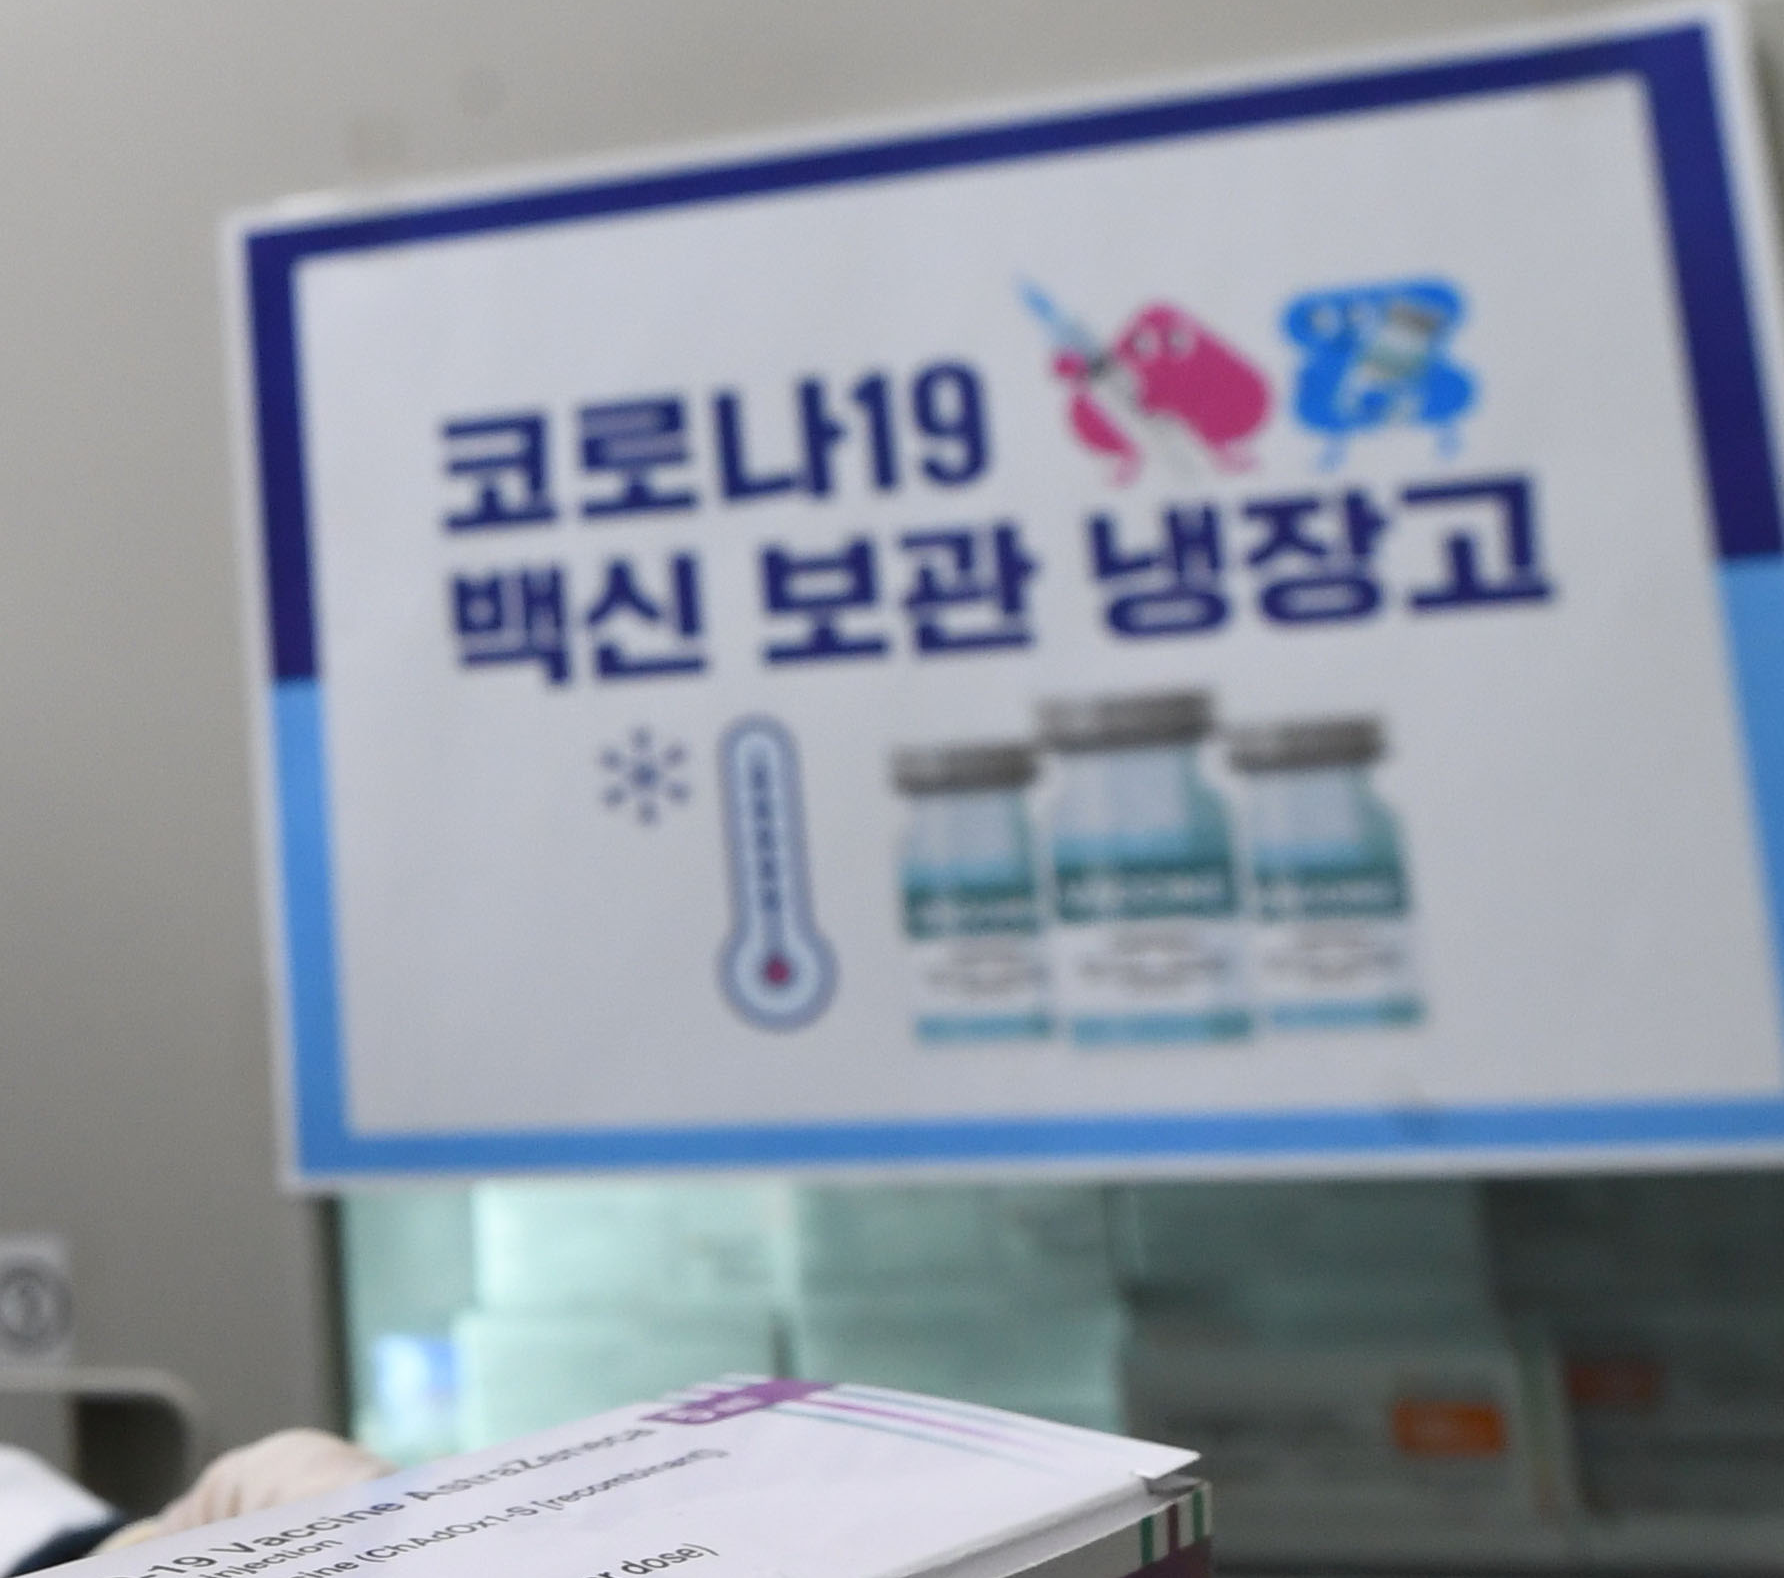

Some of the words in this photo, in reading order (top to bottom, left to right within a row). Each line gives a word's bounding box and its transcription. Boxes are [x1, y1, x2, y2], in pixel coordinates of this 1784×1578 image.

[439, 357, 990, 537] 코로나19
[448, 543, 707, 691] 백신
[758, 521, 1037, 666] 보관
[1087, 471, 1556, 641] 냉장고
[211, 1501, 405, 1555] Vaccine
[404, 1427, 657, 1503] AstraZeneca
[357, 1504, 538, 1563] (ChAdOx1-S
[620, 1542, 718, 1577] dose)
